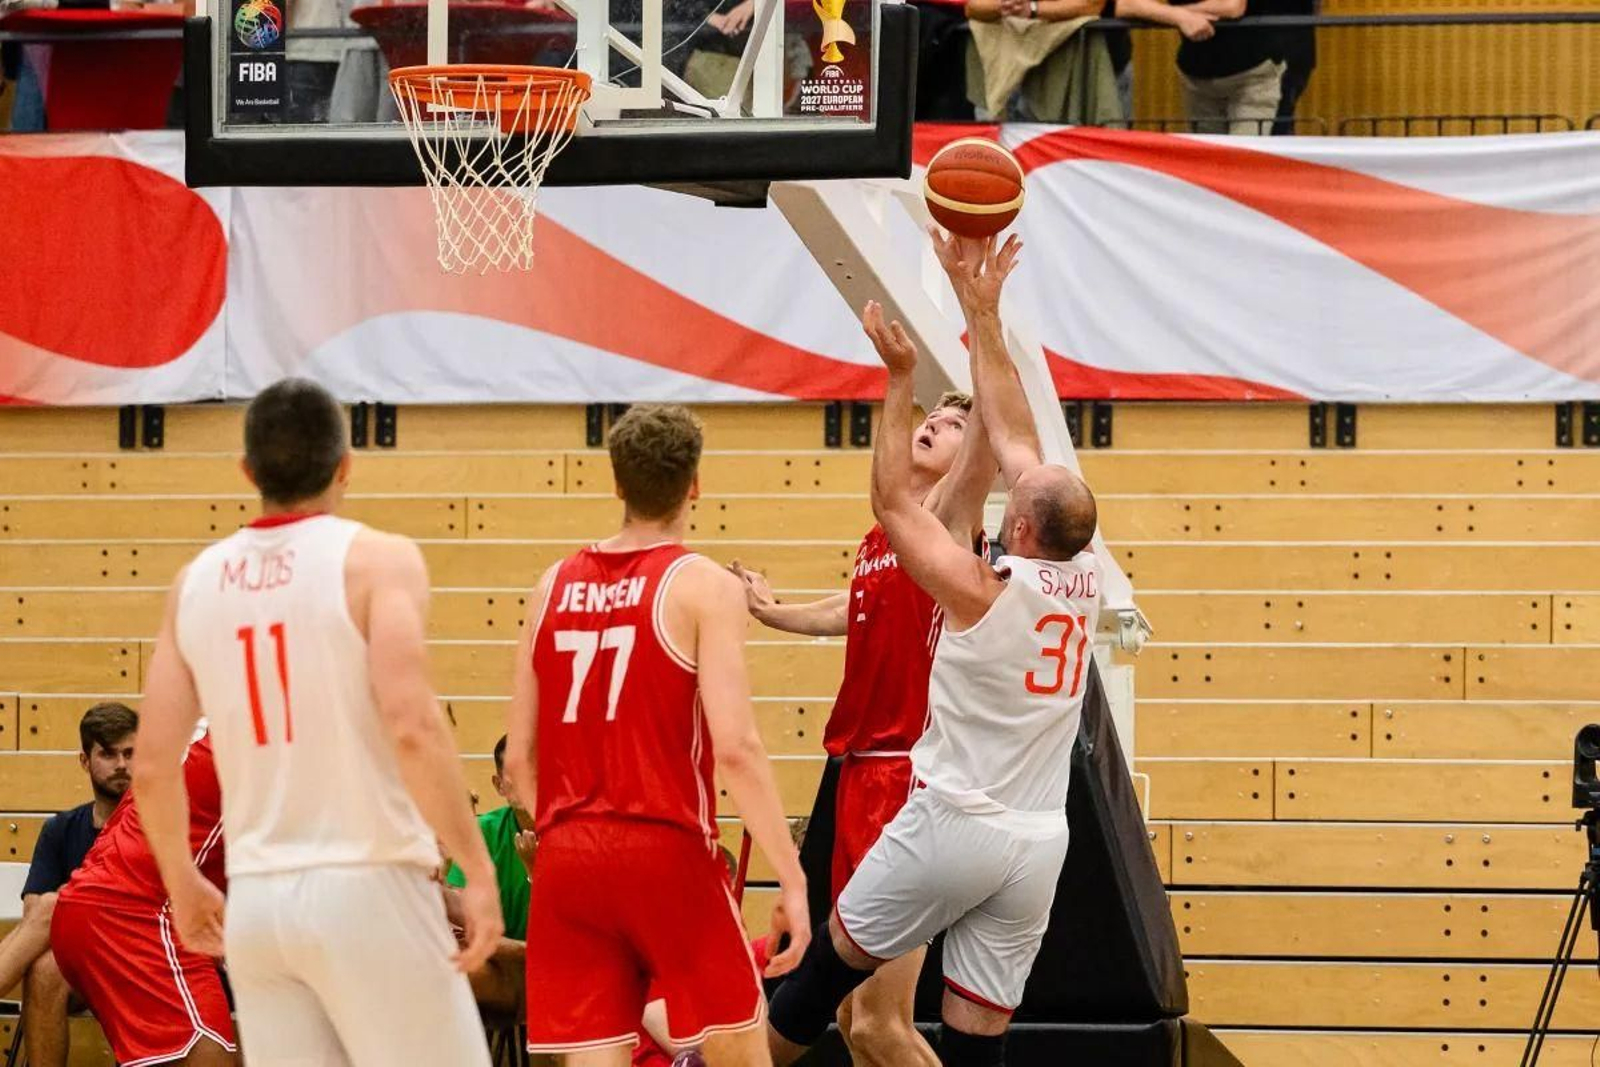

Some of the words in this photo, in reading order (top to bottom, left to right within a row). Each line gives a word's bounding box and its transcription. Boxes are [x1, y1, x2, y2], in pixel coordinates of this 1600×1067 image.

[239, 62, 277, 82] FIBA
[801, 85, 840, 94] WORLD
[842, 85, 864, 94] CUP
[801, 95, 821, 104] 2027
[822, 95, 863, 104] EUROPEAN
[555, 575, 647, 614] JENSEN
[553, 625, 637, 724] 77
[1024, 613, 1088, 698] 31
[236, 622, 293, 746] 11
